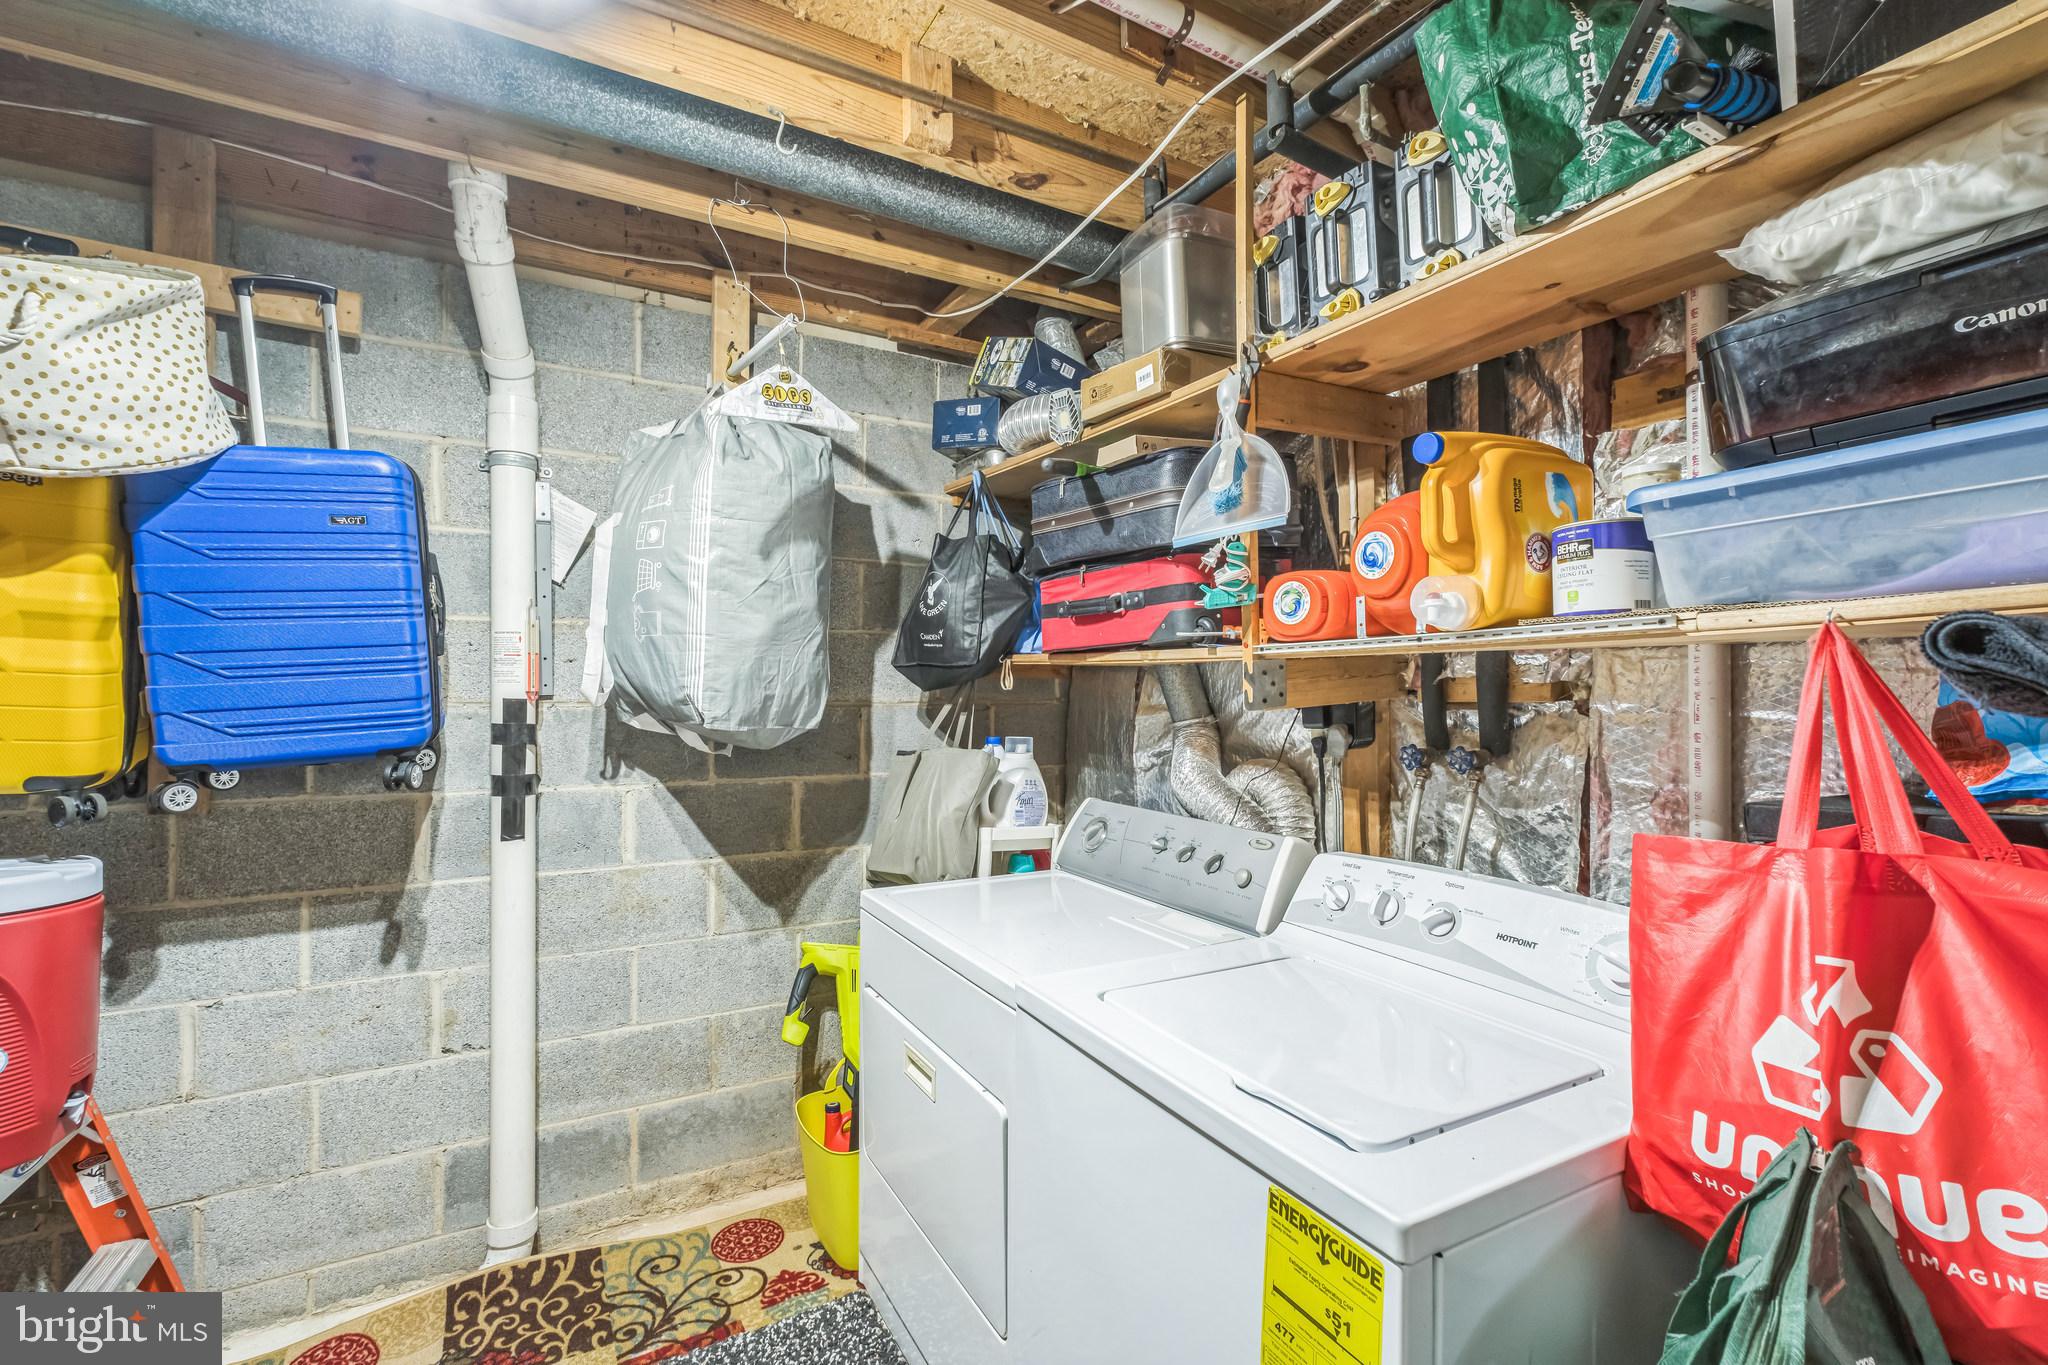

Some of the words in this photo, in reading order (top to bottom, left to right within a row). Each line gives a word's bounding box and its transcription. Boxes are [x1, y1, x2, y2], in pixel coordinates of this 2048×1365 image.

[1954, 298, 2048, 332] Canon
[342, 517, 362, 525] AGT
[1557, 542, 1579, 555] BEHR
[927, 599, 948, 617] GREEN
[1387, 869, 1415, 880] Temperature
[1445, 881, 1465, 890] Options
[1560, 926, 1580, 936] Whites
[1496, 932, 1538, 950] HOTPOINT
[1269, 1193, 1383, 1292] ENERGYGUIDE
[1325, 1307, 1351, 1338] $51
[1274, 1322, 1296, 1344] 477
